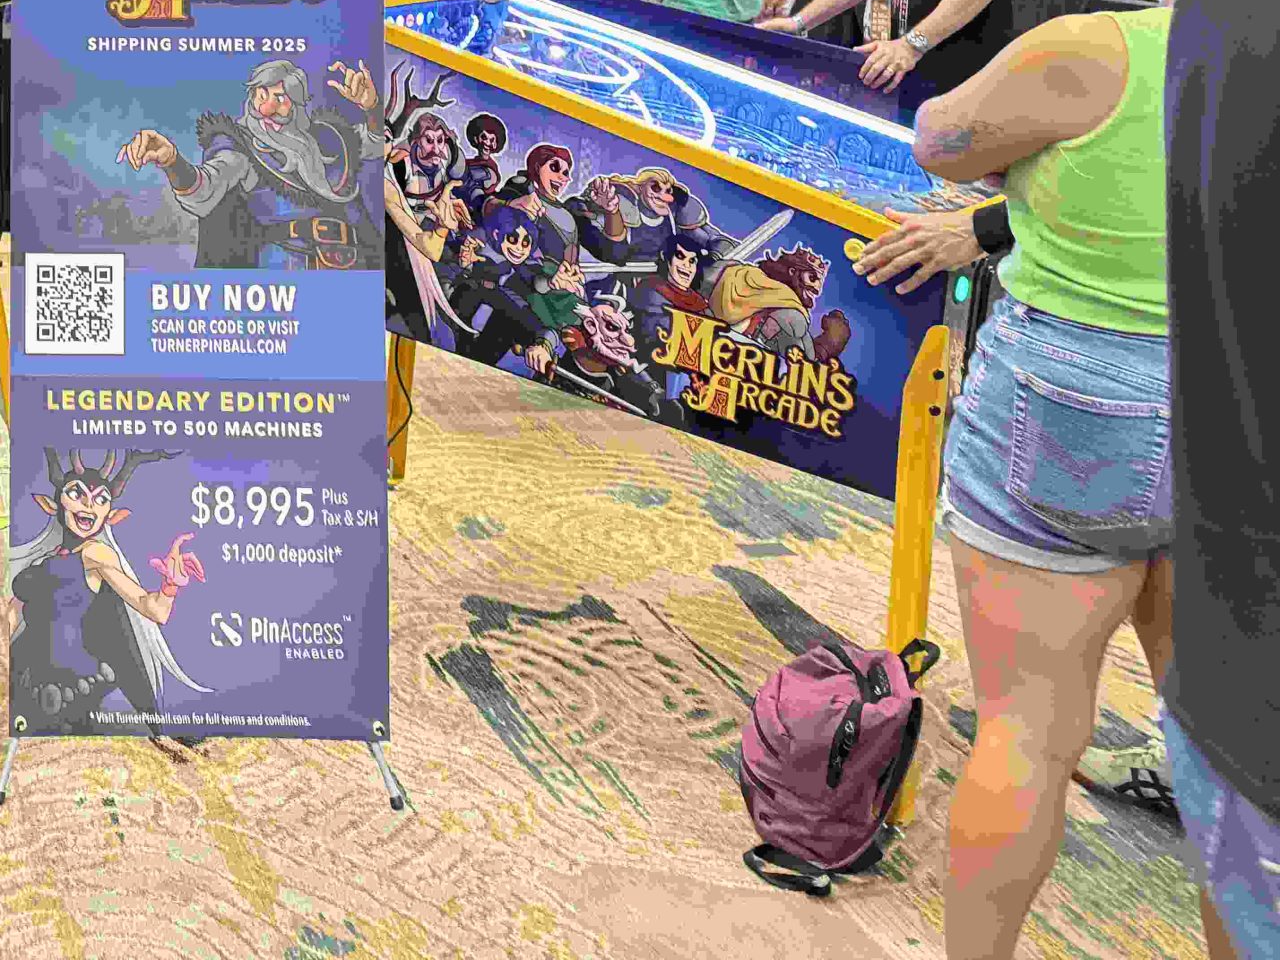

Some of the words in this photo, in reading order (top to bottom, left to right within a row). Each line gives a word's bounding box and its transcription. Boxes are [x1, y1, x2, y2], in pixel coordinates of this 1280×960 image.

[87, 37, 175, 52] SHIPPING
[178, 38, 258, 53] SUMMER
[262, 38, 306, 53] 2025
[151, 284, 211, 311] BUY
[223, 284, 297, 312] NOW
[151, 319, 184, 334] SCAN
[188, 319, 206, 334] QR
[209, 320, 244, 335] CODE
[247, 320, 265, 335] OR
[268, 320, 300, 335] VISIT
[151, 338, 287, 354] TURNERPINBALL.COM
[651, 306, 855, 411] MERLIN'S
[47, 389, 210, 412] LEGENDARY
[683, 371, 842, 438] ARCADE
[73, 419, 146, 436] LIMITED
[153, 420, 177, 436] TO
[184, 421, 218, 437] 500
[225, 421, 323, 438] MACHINES
[191, 482, 315, 529] $8,995
[322, 488, 349, 505] Plus
[321, 509, 342, 526] Tax
[344, 510, 354, 526] &
[356, 509, 379, 527] S/H
[222, 542, 275, 564] $1,000
[285, 648, 345, 659] ENABLED
[96, 711, 115, 724] Visit
[116, 712, 191, 725] TurnerPinball.com
[192, 712, 205, 725] for
[205, 713, 220, 725] full
[221, 714, 245, 726] terms
[246, 714, 263, 726] and
